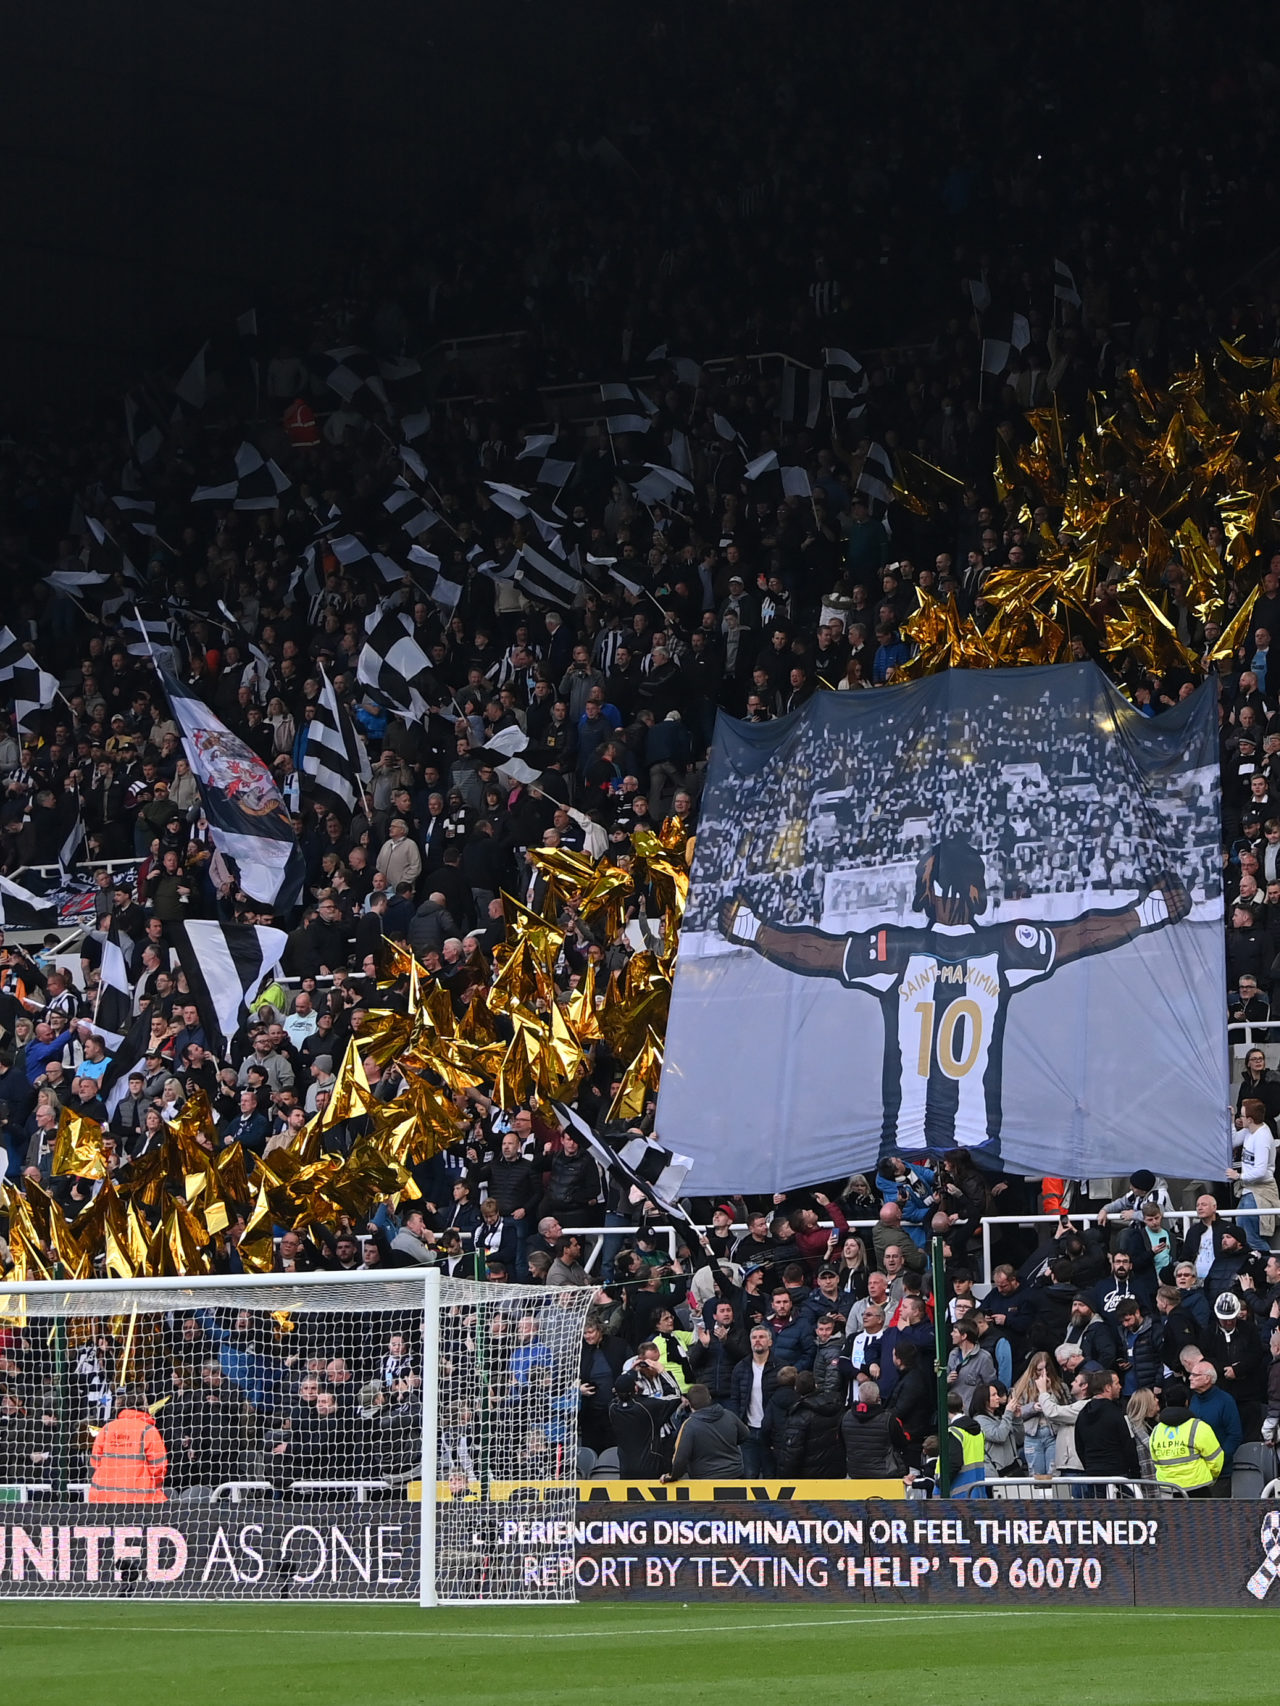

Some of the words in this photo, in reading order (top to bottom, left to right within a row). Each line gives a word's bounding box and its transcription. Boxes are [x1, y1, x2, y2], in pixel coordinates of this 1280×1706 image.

[898, 964, 1000, 1002] SAINT-MAXIMIN
[914, 996, 983, 1080] 10
[1157, 1440, 1185, 1448] ALPHA
[653, 1520, 863, 1544] DISCRIMINATION
[869, 1520, 908, 1544] OR
[913, 1520, 970, 1544] FEEL
[974, 1520, 1158, 1545] THREATENED?
[0, 1526, 188, 1581] NITED
[202, 1525, 264, 1582] AS
[281, 1525, 402, 1583] ONE
[524, 1557, 638, 1587] REPORT
[645, 1557, 684, 1587] BY
[689, 1557, 828, 1587] TEXTING
[949, 1556, 999, 1587] TO
[1008, 1557, 1102, 1588] 60070
